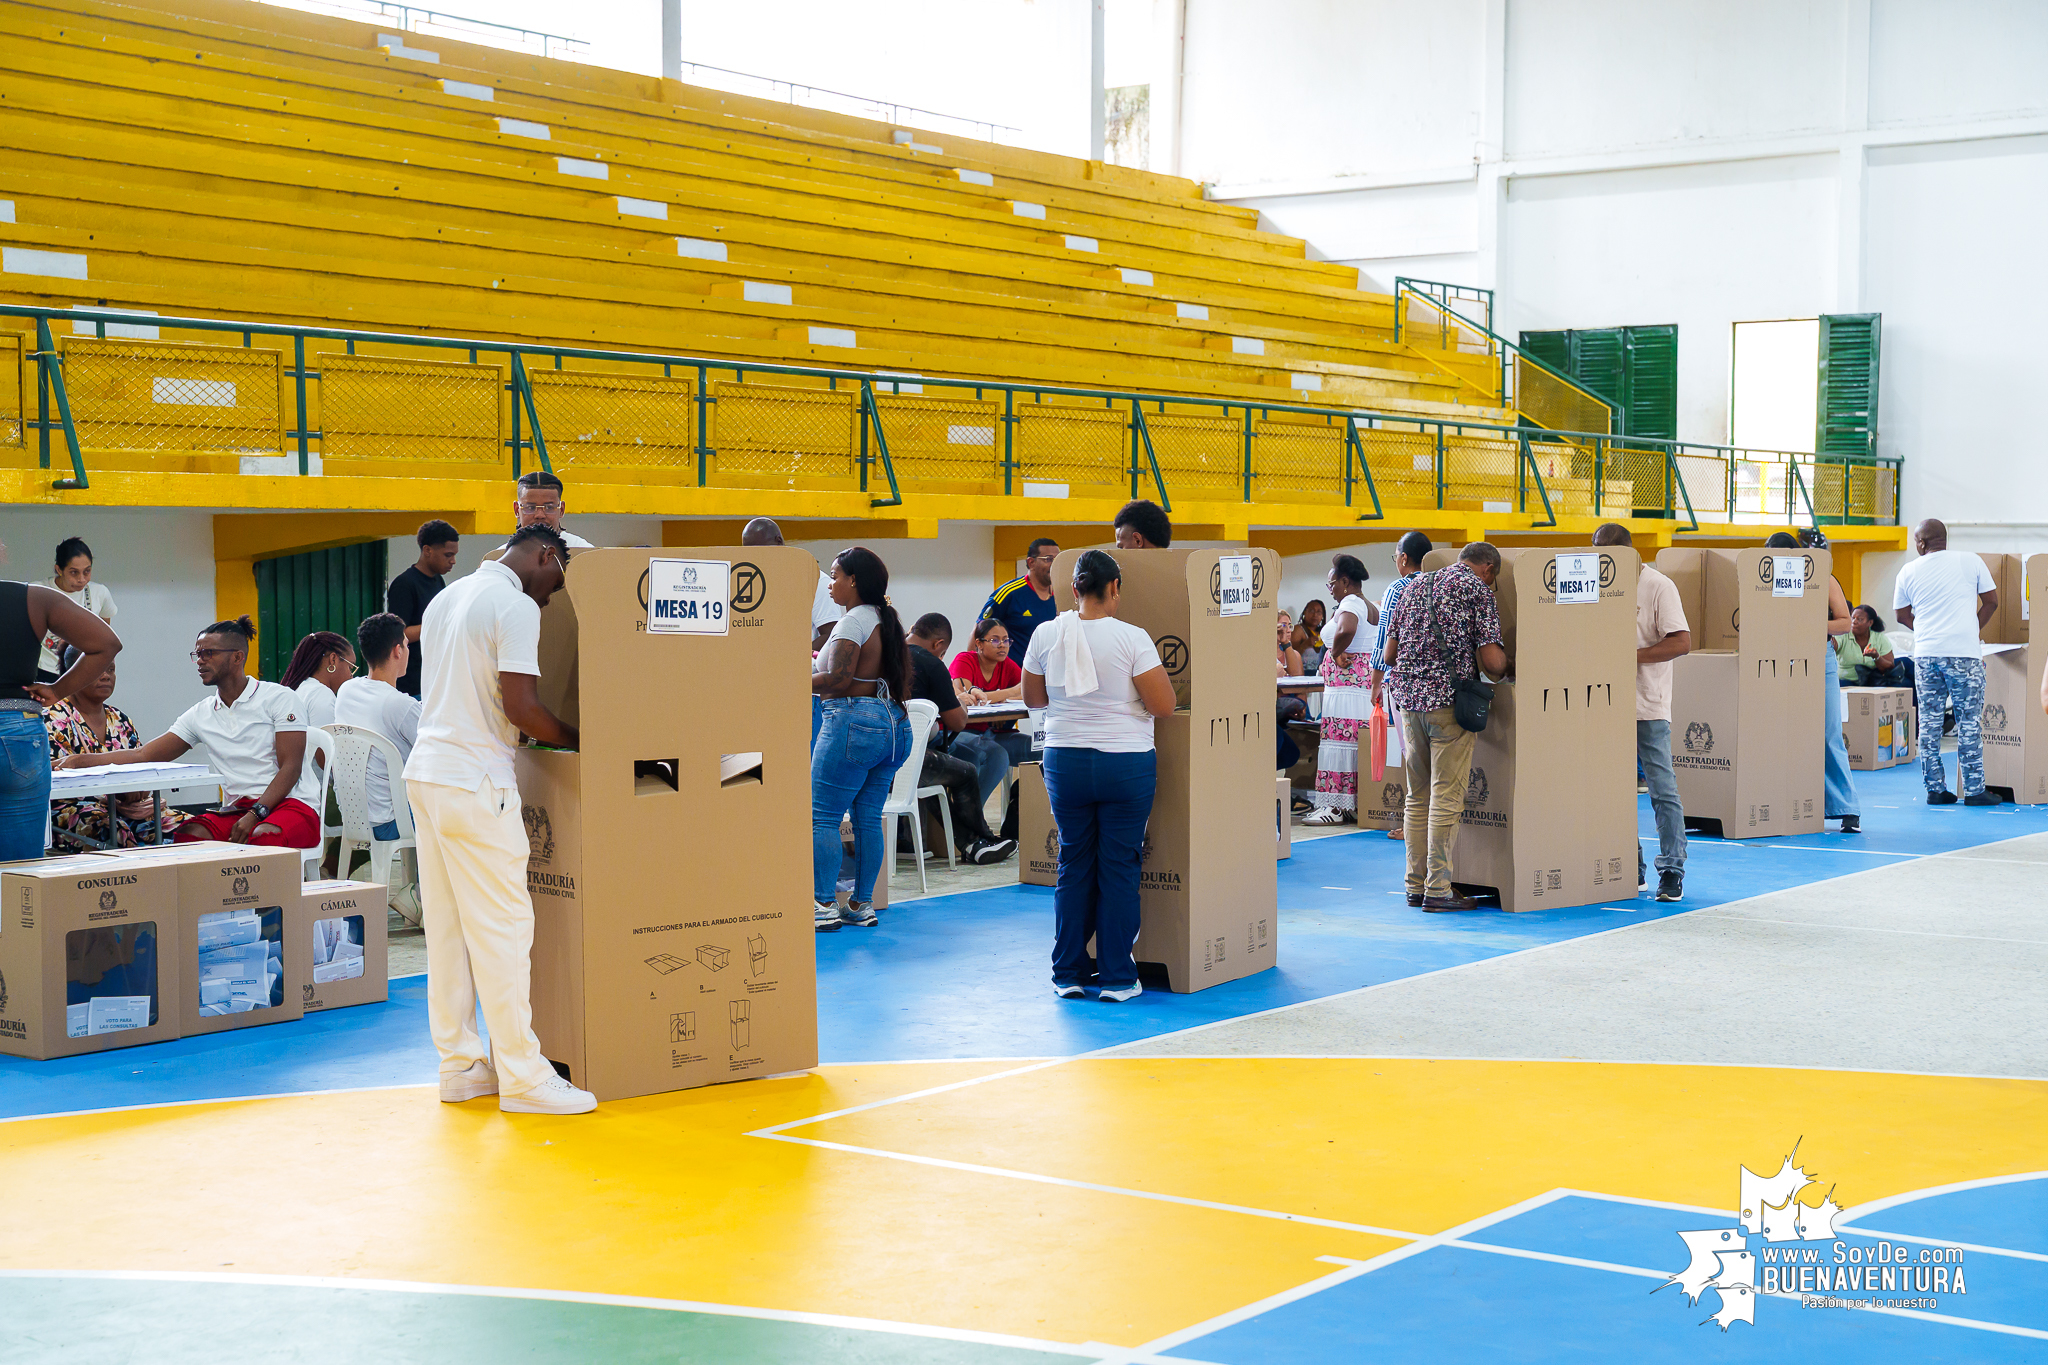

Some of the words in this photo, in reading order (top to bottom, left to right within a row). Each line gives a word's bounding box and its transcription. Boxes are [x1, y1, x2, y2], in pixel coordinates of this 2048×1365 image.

[1559, 580, 1583, 594] MESA
[1584, 580, 1596, 593] 17
[1775, 578, 1792, 588] MESA
[1793, 578, 1802, 589] 16
[1222, 588, 1241, 605] MESA
[1241, 587, 1250, 603] 18
[1606, 589, 1625, 598] celular
[655, 599, 699, 619] MESA
[701, 600, 723, 620] 19
[1256, 599, 1271, 609] celular
[731, 616, 765, 628] celular
[1474, 819, 1494, 827] ESTADO
[1494, 821, 1508, 829] CIVIL
[220, 864, 261, 877] SENADO
[77, 874, 138, 890] CONSULTAS
[527, 870, 576, 890] TRADURÍA
[538, 886, 561, 897] ESTADO
[561, 889, 576, 900] CIVIL
[1161, 883, 1182, 892] CIVIL
[320, 899, 357, 911] CÁMARA
[632, 922, 683, 935] INSTRUCCIONES
[684, 920, 702, 929] PARA
[711, 916, 738, 926] ARMADO
[738, 915, 751, 923] DEL
[751, 910, 783, 922] CUBICULO
[110, 1022, 138, 1030] CONSULTAS
